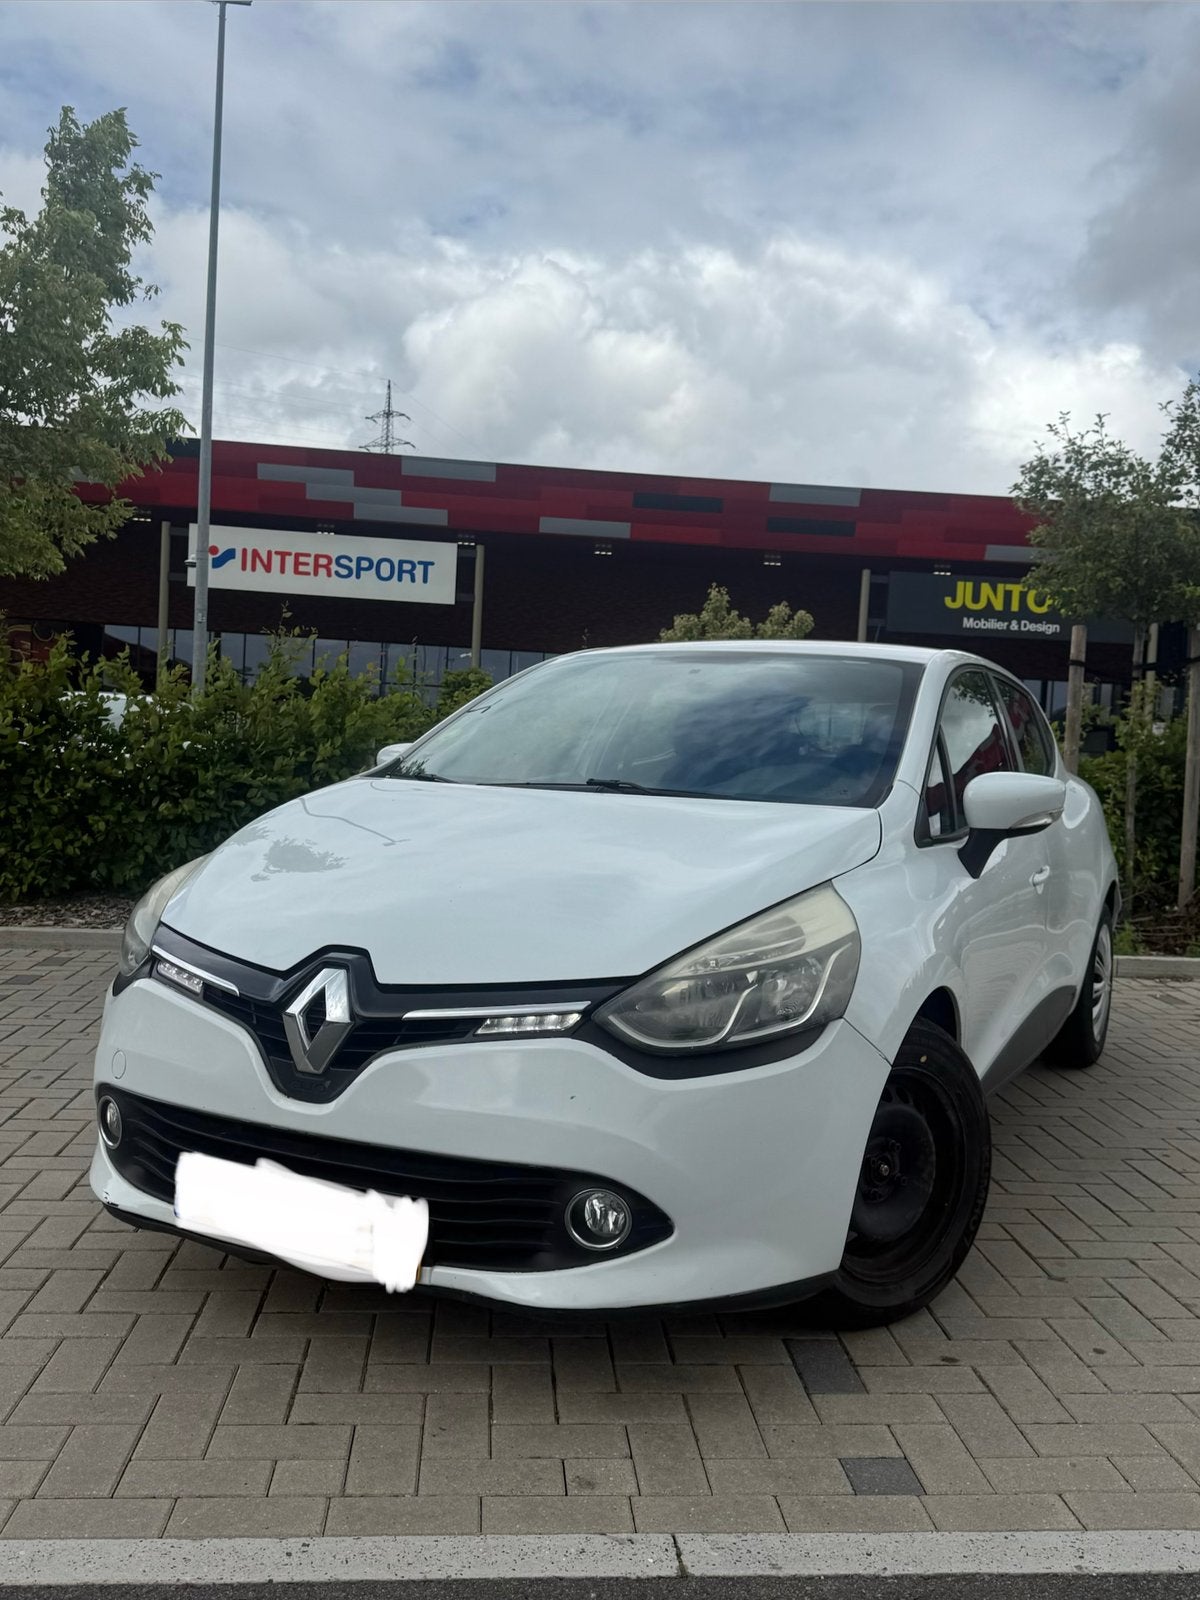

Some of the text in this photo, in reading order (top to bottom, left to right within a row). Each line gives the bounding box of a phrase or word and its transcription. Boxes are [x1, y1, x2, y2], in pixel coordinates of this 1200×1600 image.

[241, 547, 435, 584] INTERSPORT
[962, 617, 1060, 634] Mobilier & Design
